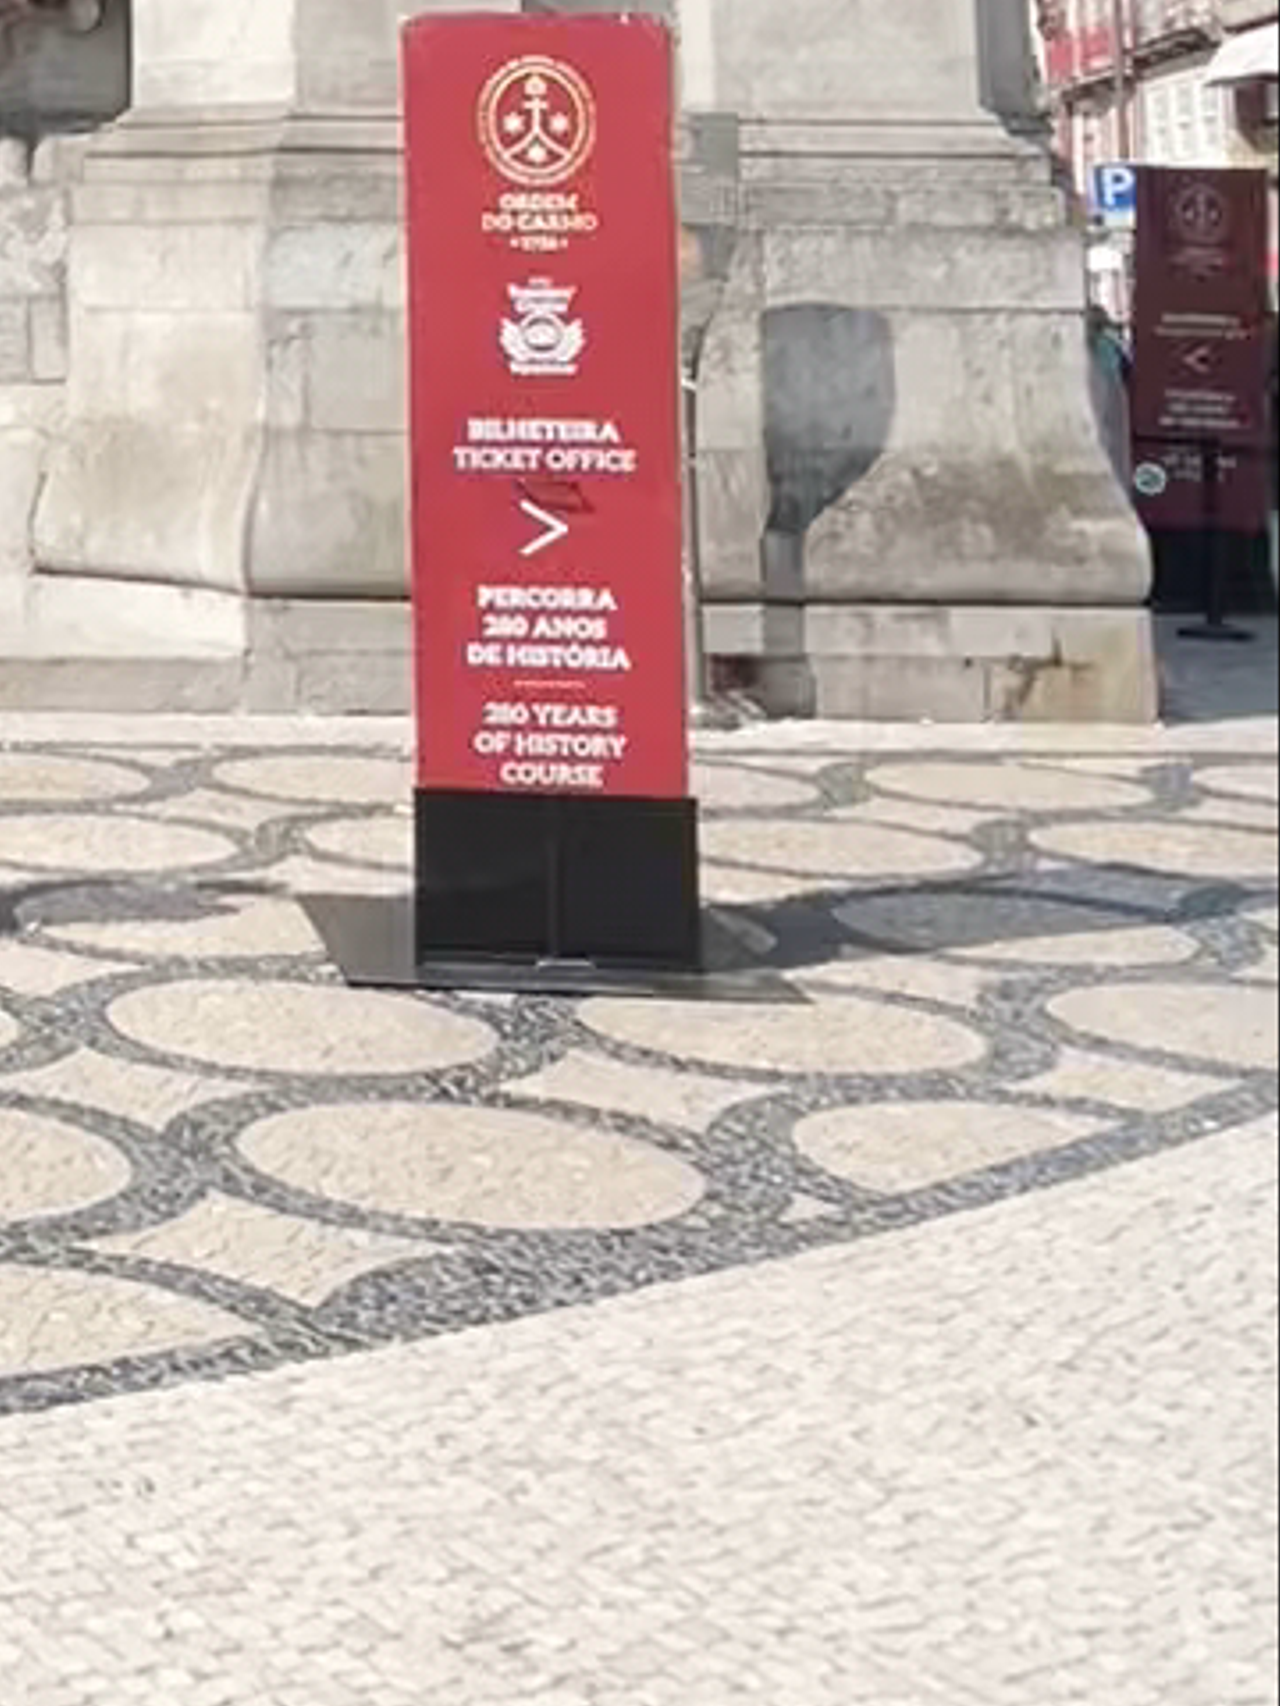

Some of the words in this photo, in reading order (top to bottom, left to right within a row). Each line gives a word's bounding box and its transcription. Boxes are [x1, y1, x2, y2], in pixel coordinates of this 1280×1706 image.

[1102, 168, 1134, 205] P
[499, 192, 579, 211] ORDEM
[481, 212, 513, 231] DO
[517, 213, 598, 231] CARMO
[468, 418, 620, 443] BILHETEIRA
[453, 446, 541, 470] TICKET
[545, 448, 637, 472] OFFICE
[477, 585, 618, 611] PERCORRA
[532, 615, 608, 640] ANOS
[467, 643, 503, 667] DE
[506, 641, 632, 671] HISTÓRIA
[531, 703, 618, 728] YEARS
[473, 730, 512, 754] OF
[514, 732, 629, 758] HISTORY
[500, 761, 604, 787] COURSE
